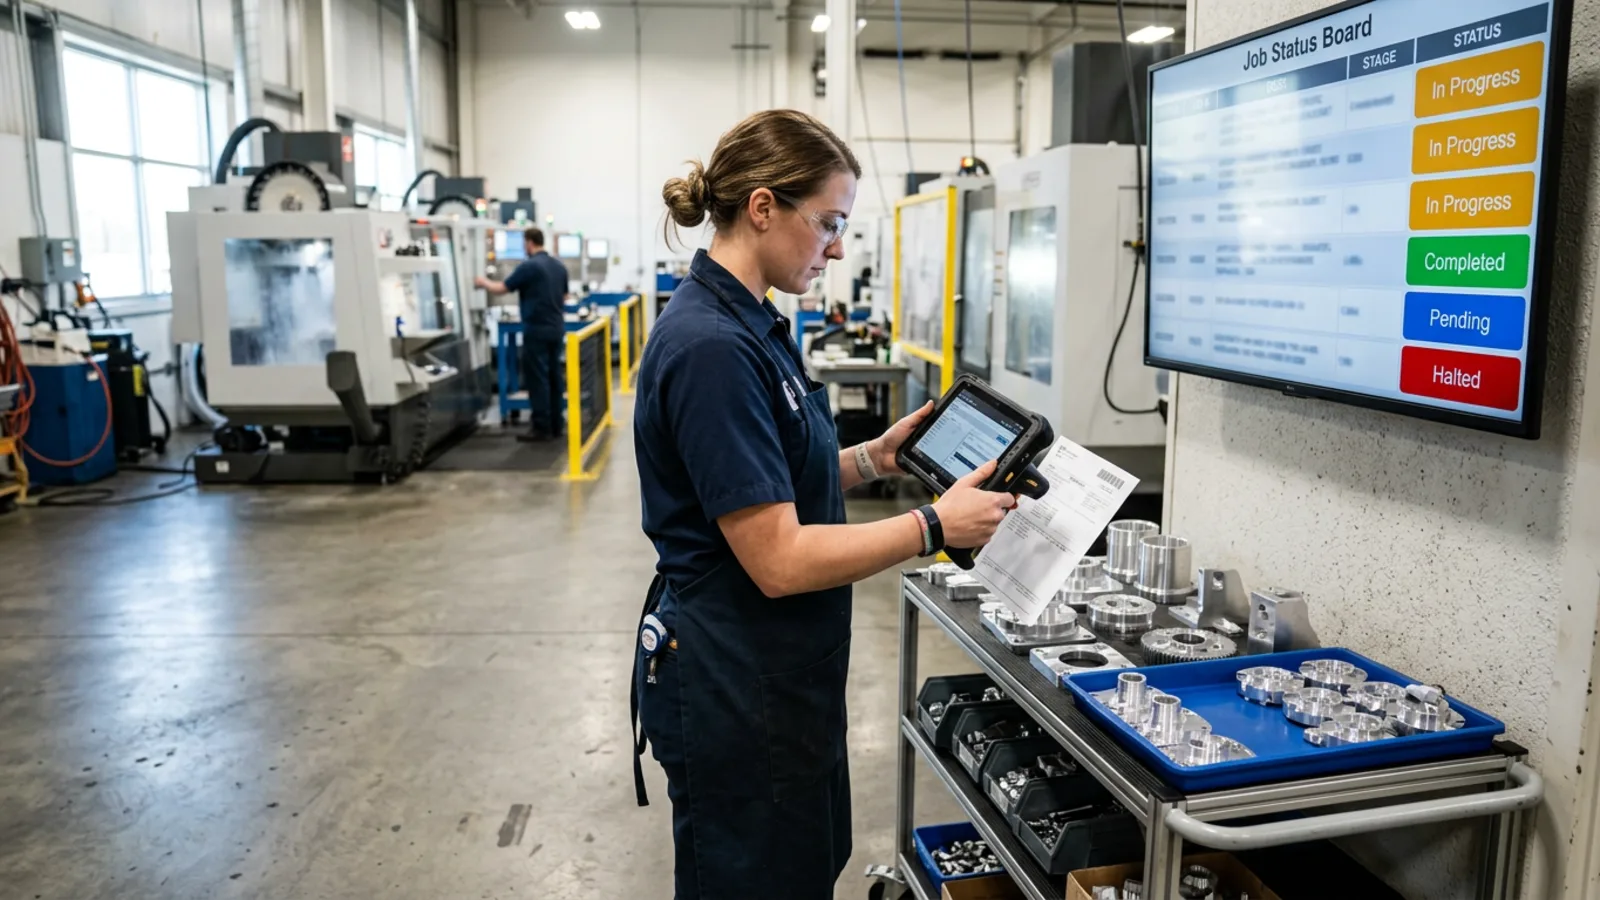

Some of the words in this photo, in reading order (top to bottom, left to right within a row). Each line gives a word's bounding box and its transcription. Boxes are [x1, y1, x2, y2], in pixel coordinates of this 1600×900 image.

[1243, 48, 1267, 71] Job
[1272, 36, 1317, 62] Status
[1323, 14, 1372, 48] Board
[1454, 23, 1502, 47] STATUS
[1363, 51, 1397, 70] STAGE
[1432, 82, 1445, 99] In
[1450, 67, 1520, 97] Progress
[1429, 140, 1442, 156] In
[1447, 132, 1516, 157] Progress
[1426, 198, 1439, 214] In
[1443, 194, 1512, 217] Progress
[1424, 252, 1505, 273] Completed
[1430, 309, 1491, 335] Pending
[1432, 366, 1481, 389] Halted
